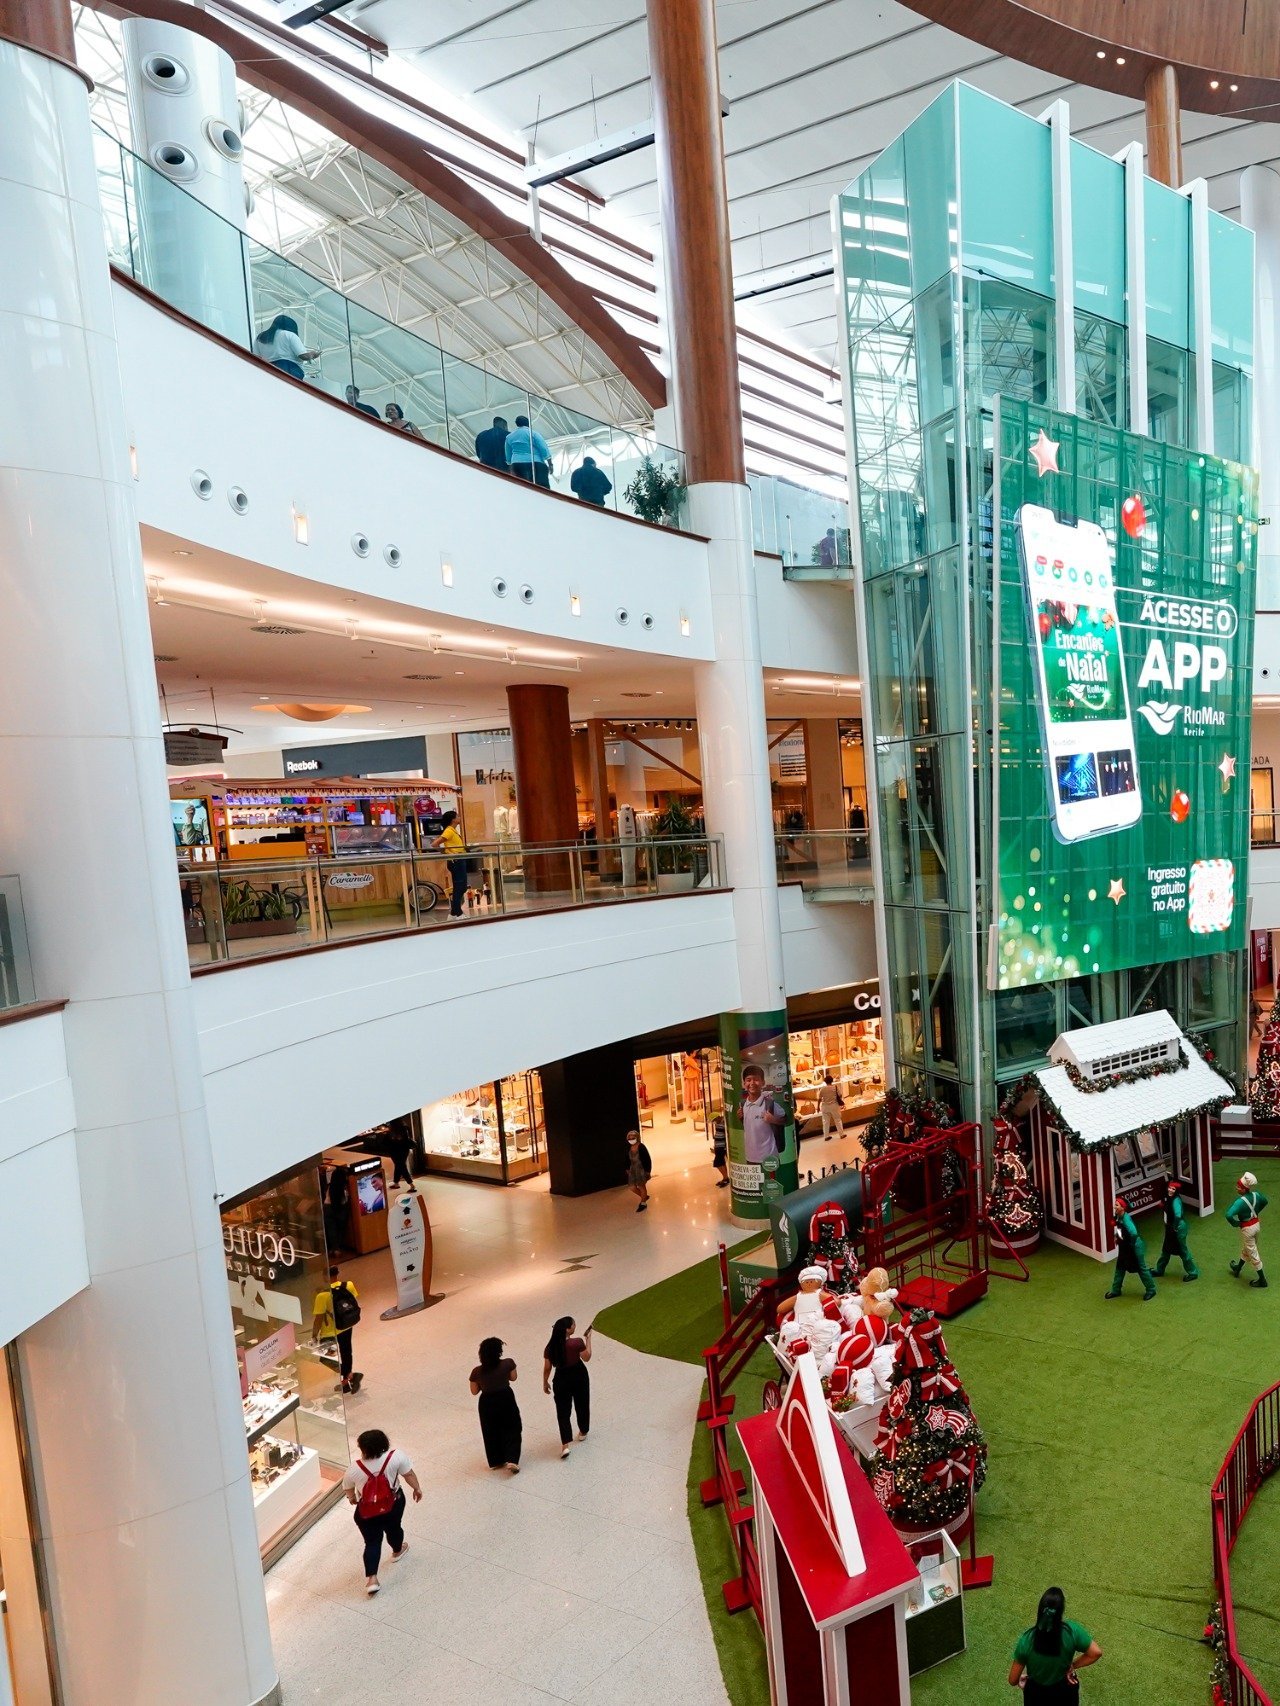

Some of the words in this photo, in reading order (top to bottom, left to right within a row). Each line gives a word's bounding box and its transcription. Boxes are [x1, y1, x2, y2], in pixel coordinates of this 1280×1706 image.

[1140, 599, 1214, 630] ACESSE
[1216, 609, 1231, 632] O
[1065, 651, 1108, 681] Natal
[1137, 639, 1227, 692] APP
[286, 759, 319, 772] Reebok
[1147, 867, 1187, 883] Ingresso
[1151, 881, 1185, 899] gratuito
[1153, 900, 1165, 911] no
[1166, 896, 1185, 912] App
